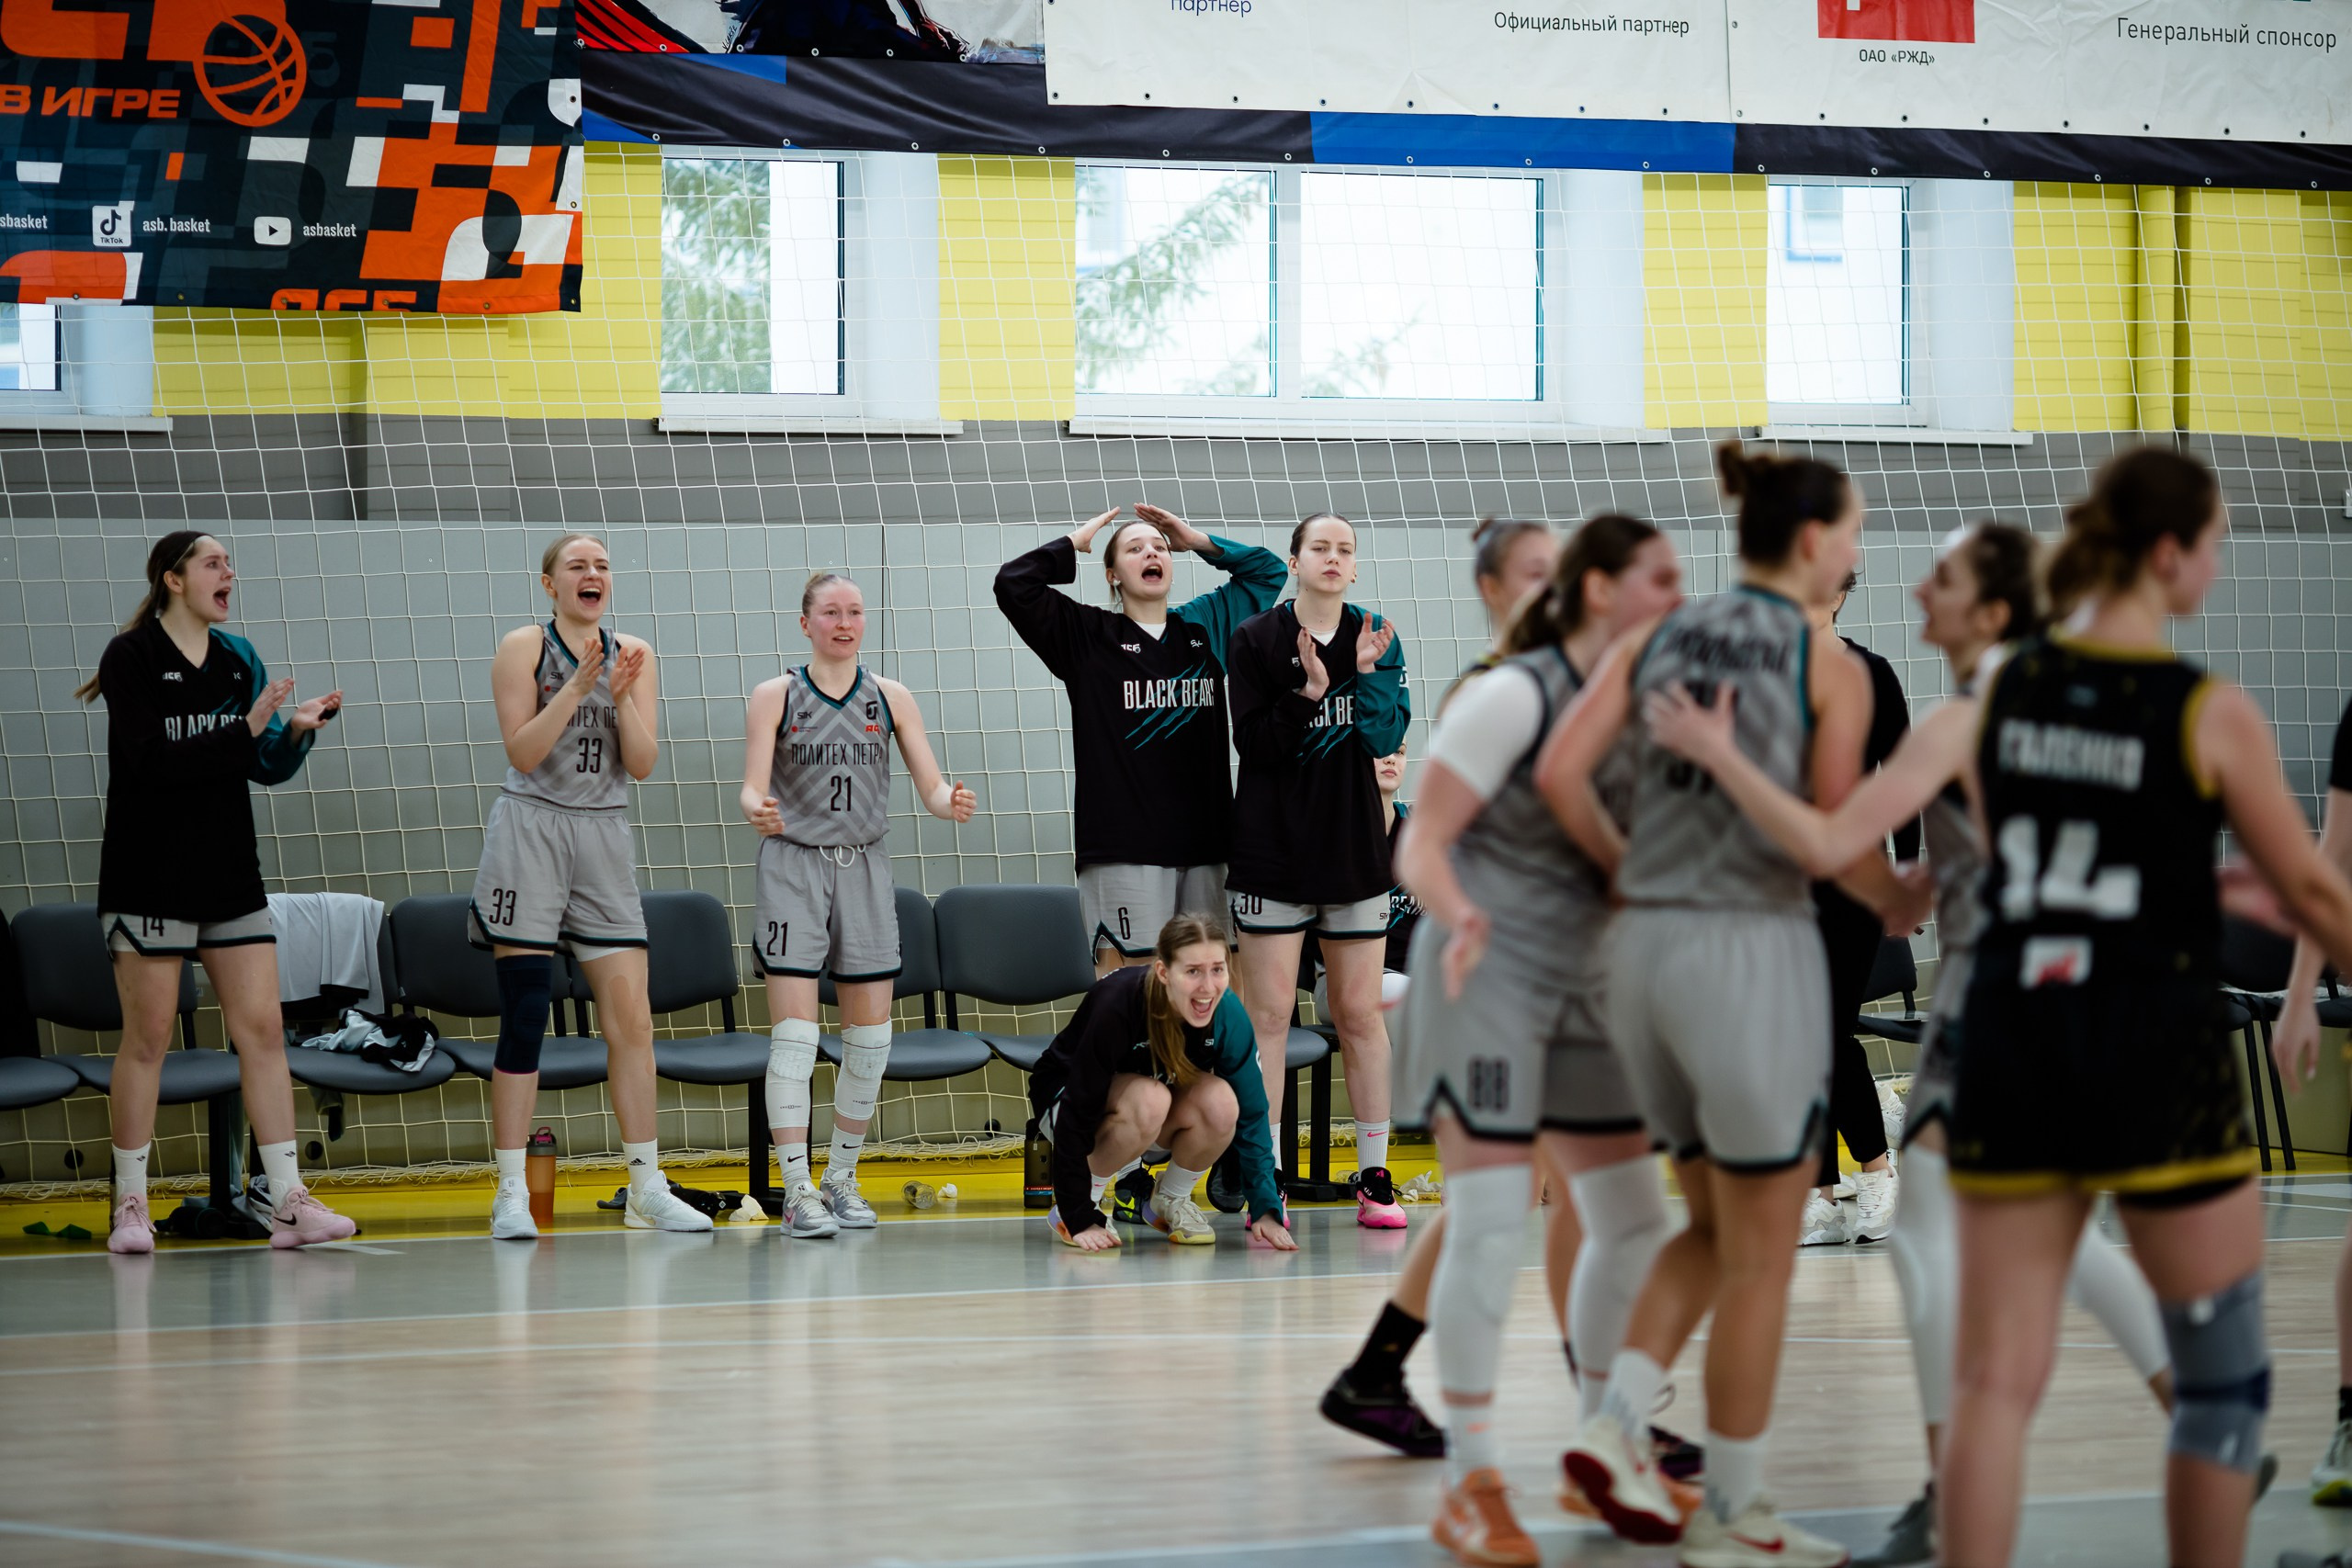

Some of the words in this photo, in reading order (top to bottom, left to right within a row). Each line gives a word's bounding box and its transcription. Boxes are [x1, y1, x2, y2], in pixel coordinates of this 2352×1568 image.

[1494, 12, 1617, 33] Официальный
[1623, 18, 1690, 38] партнер
[2117, 17, 2250, 45] Генеральный
[2256, 29, 2337, 53] спонсор
[1859, 49, 1886, 62] ОАО
[1891, 50, 1936, 66] «РЖД»
[0, 84, 31, 115] В
[40, 85, 181, 118] ИГРЕ
[100, 236, 124, 244] TikTok
[302, 222, 357, 237] asbasket
[1124, 679, 1178, 710] BLACK
[1182, 678, 1215, 707] BEARS
[576, 737, 603, 773] 33
[791, 743, 848, 766] ПОЛИТЕХ
[830, 775, 852, 812] 21
[1998, 813, 2142, 922] 14
[489, 887, 516, 926] 33
[1117, 906, 1131, 941] 6
[141, 916, 164, 938] 14
[766, 920, 788, 957] 21
